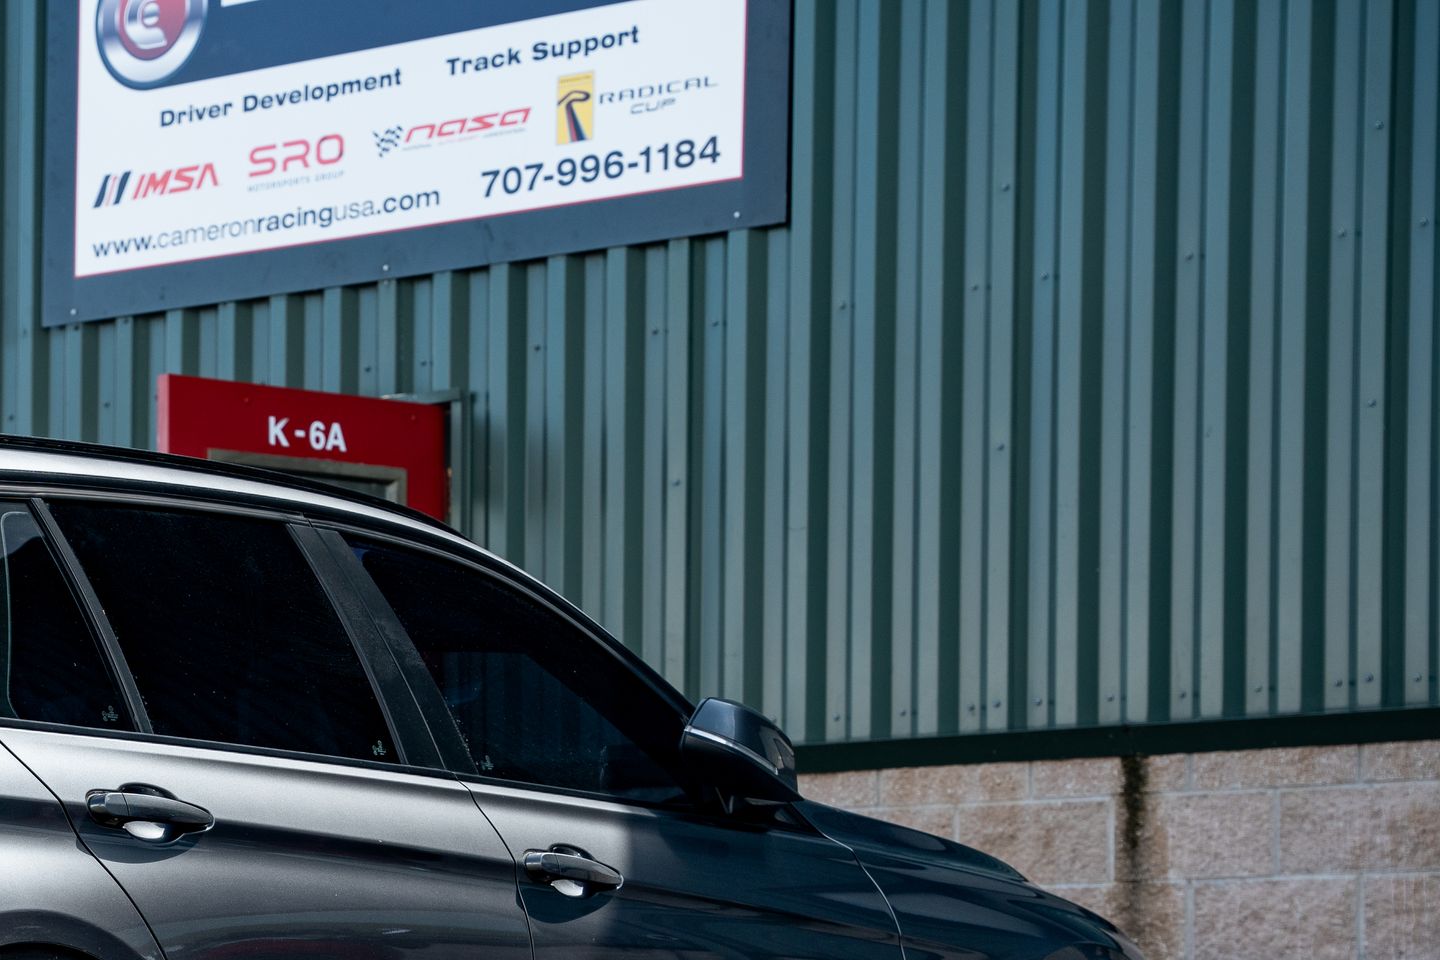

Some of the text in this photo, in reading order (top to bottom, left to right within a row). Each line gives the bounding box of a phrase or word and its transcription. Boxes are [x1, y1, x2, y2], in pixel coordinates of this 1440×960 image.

[446, 25, 639, 76] Track Support
[160, 68, 402, 127] Driver Development
[599, 76, 719, 104] RADICAL
[629, 97, 676, 115] CUP
[248, 133, 345, 177] SRO
[481, 135, 721, 198] 707-996-1184
[132, 162, 219, 200] IMSA
[92, 189, 441, 258] www.cameronracingusa.com
[268, 415, 347, 452] K-6A
